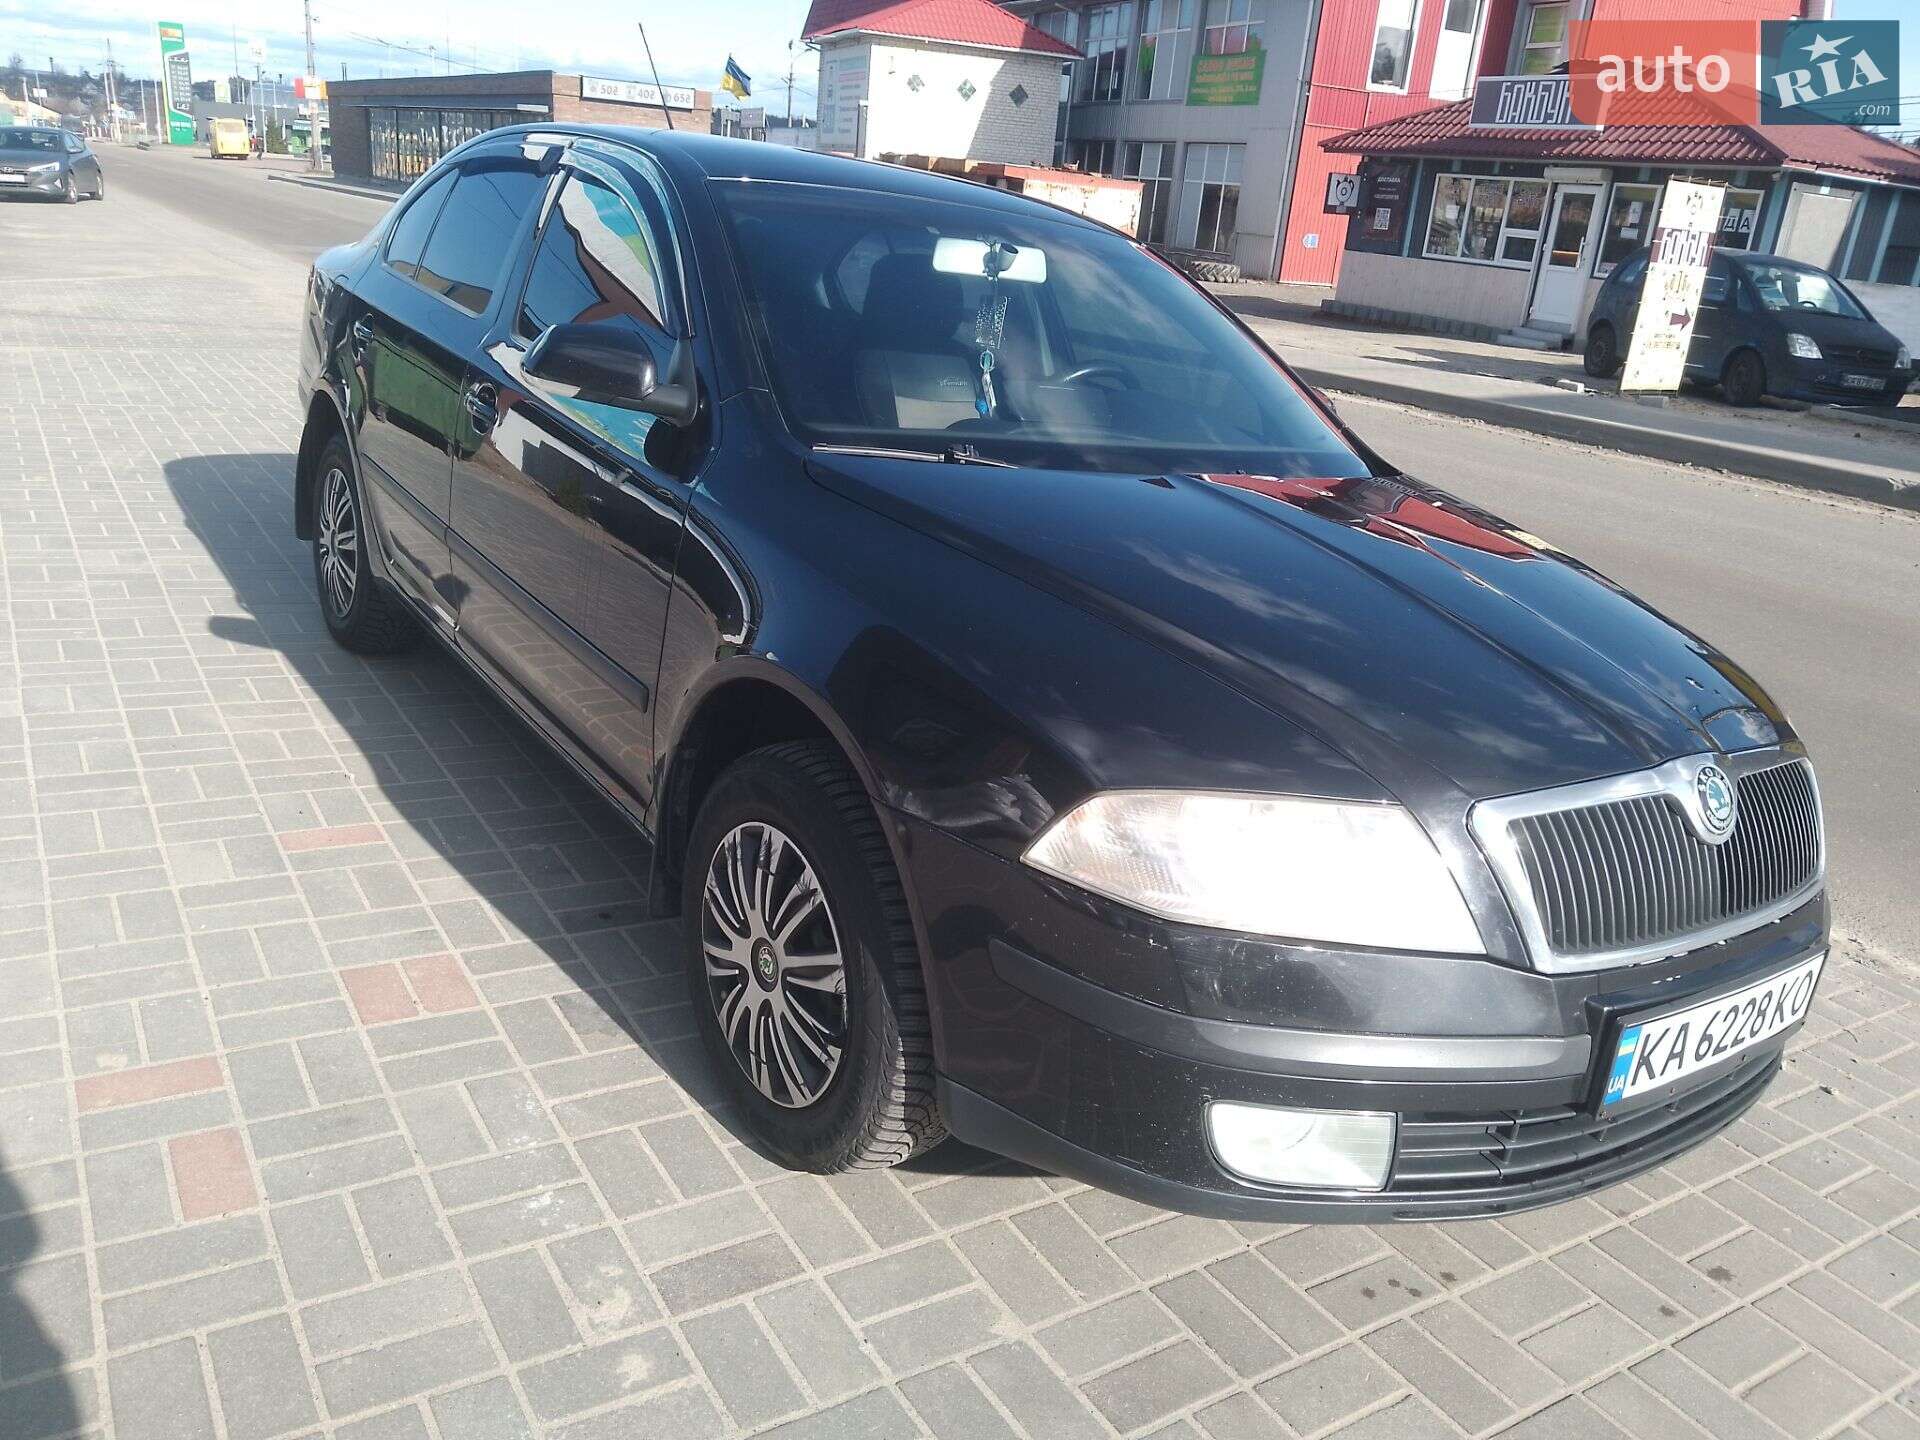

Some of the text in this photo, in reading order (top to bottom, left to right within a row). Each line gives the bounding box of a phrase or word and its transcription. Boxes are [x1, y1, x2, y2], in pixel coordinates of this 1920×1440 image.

[1630, 969, 1813, 1086] KA 6228 KO
[1609, 1077, 1625, 1093] UA
